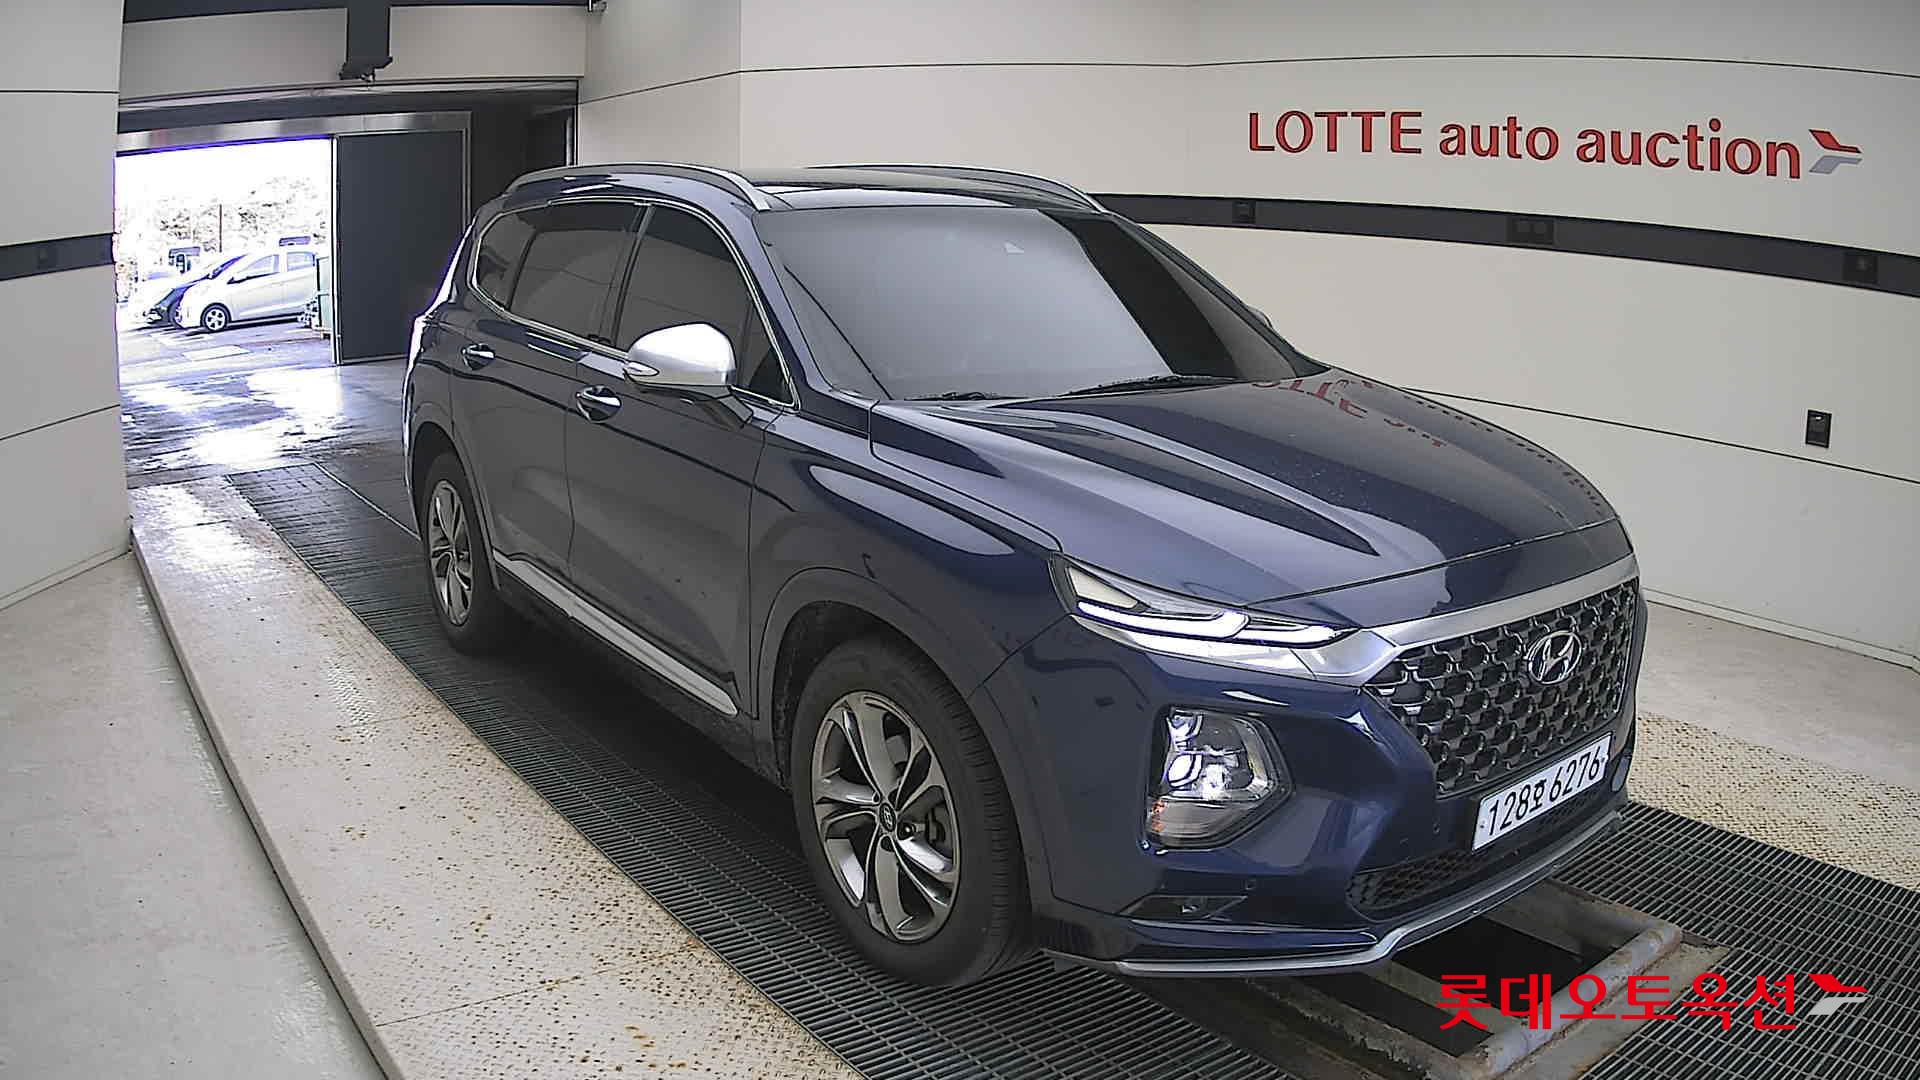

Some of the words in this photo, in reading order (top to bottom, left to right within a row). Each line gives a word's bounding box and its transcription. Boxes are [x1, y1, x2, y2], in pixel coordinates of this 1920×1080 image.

[1249, 111, 1423, 154] LOTTE
[1439, 116, 1561, 160] auto
[1576, 118, 1801, 179] auction
[1549, 746, 1601, 803] 6276
